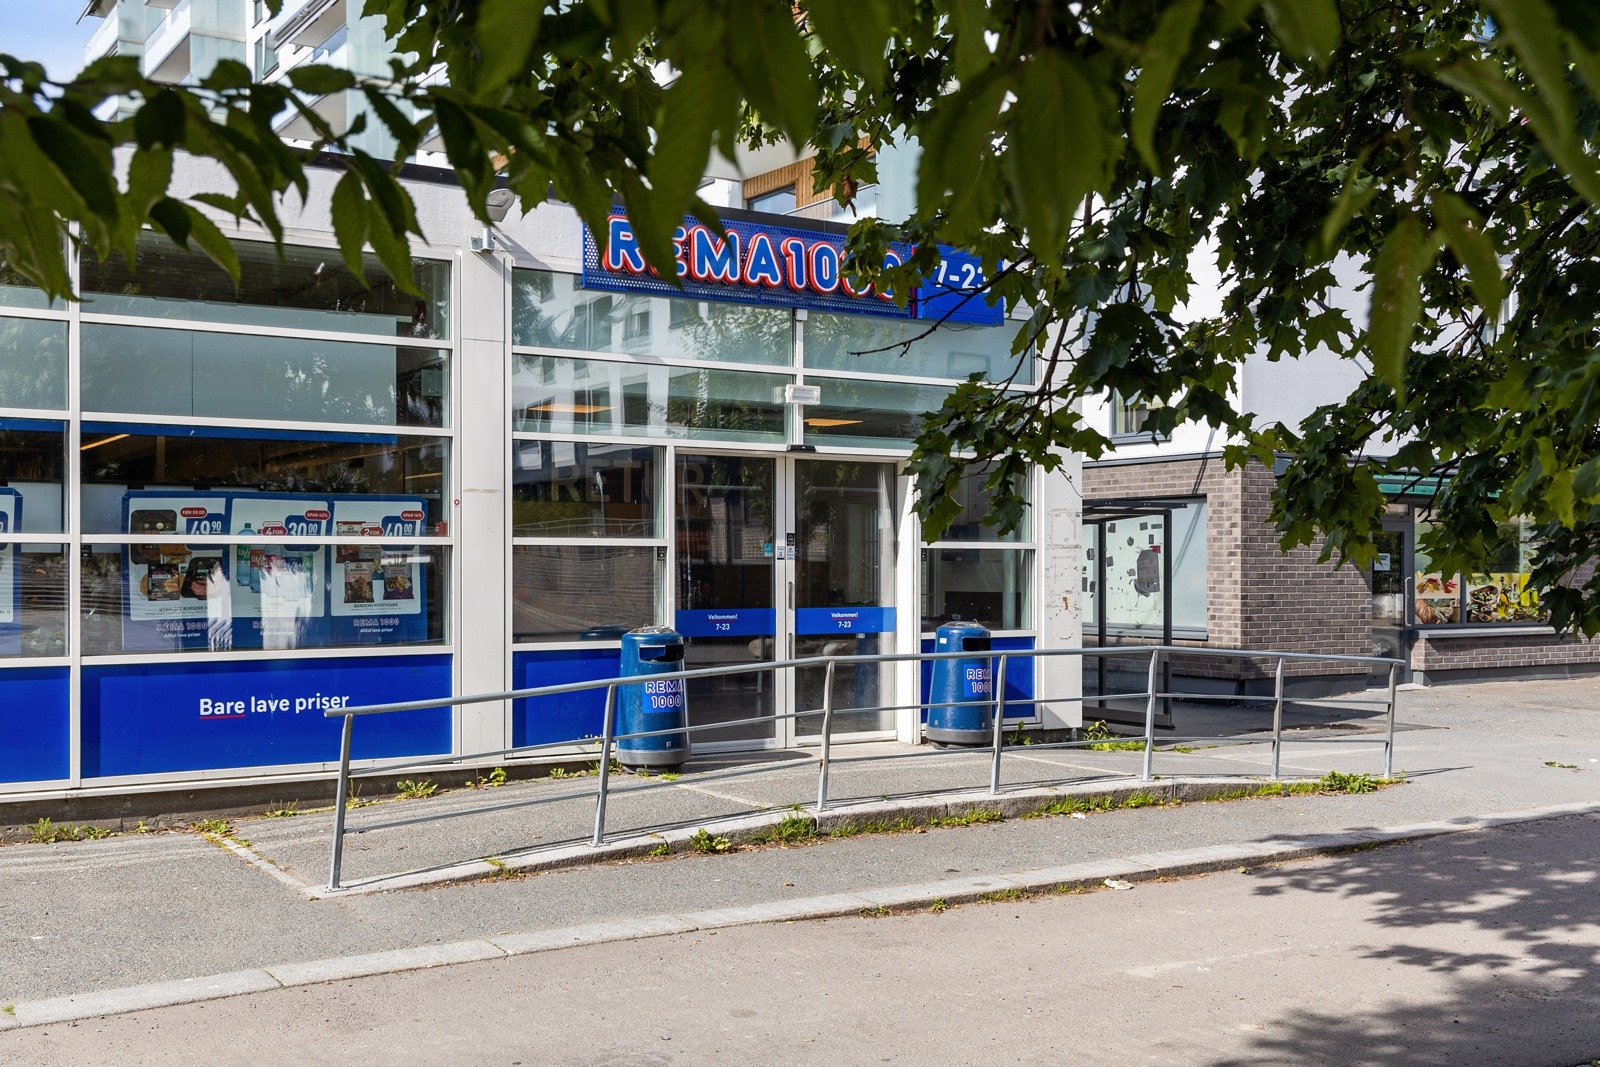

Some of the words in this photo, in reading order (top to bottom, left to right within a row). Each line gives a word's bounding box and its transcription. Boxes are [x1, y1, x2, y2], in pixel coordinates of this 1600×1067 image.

[156, 623, 185, 632] REMA
[186, 622, 208, 630] 1000
[380, 618, 400, 626] 1000
[645, 680, 684, 694] REMA
[200, 698, 246, 716] Bare
[250, 696, 290, 712] lave
[296, 692, 349, 714] priser
[651, 694, 681, 708] 1000
